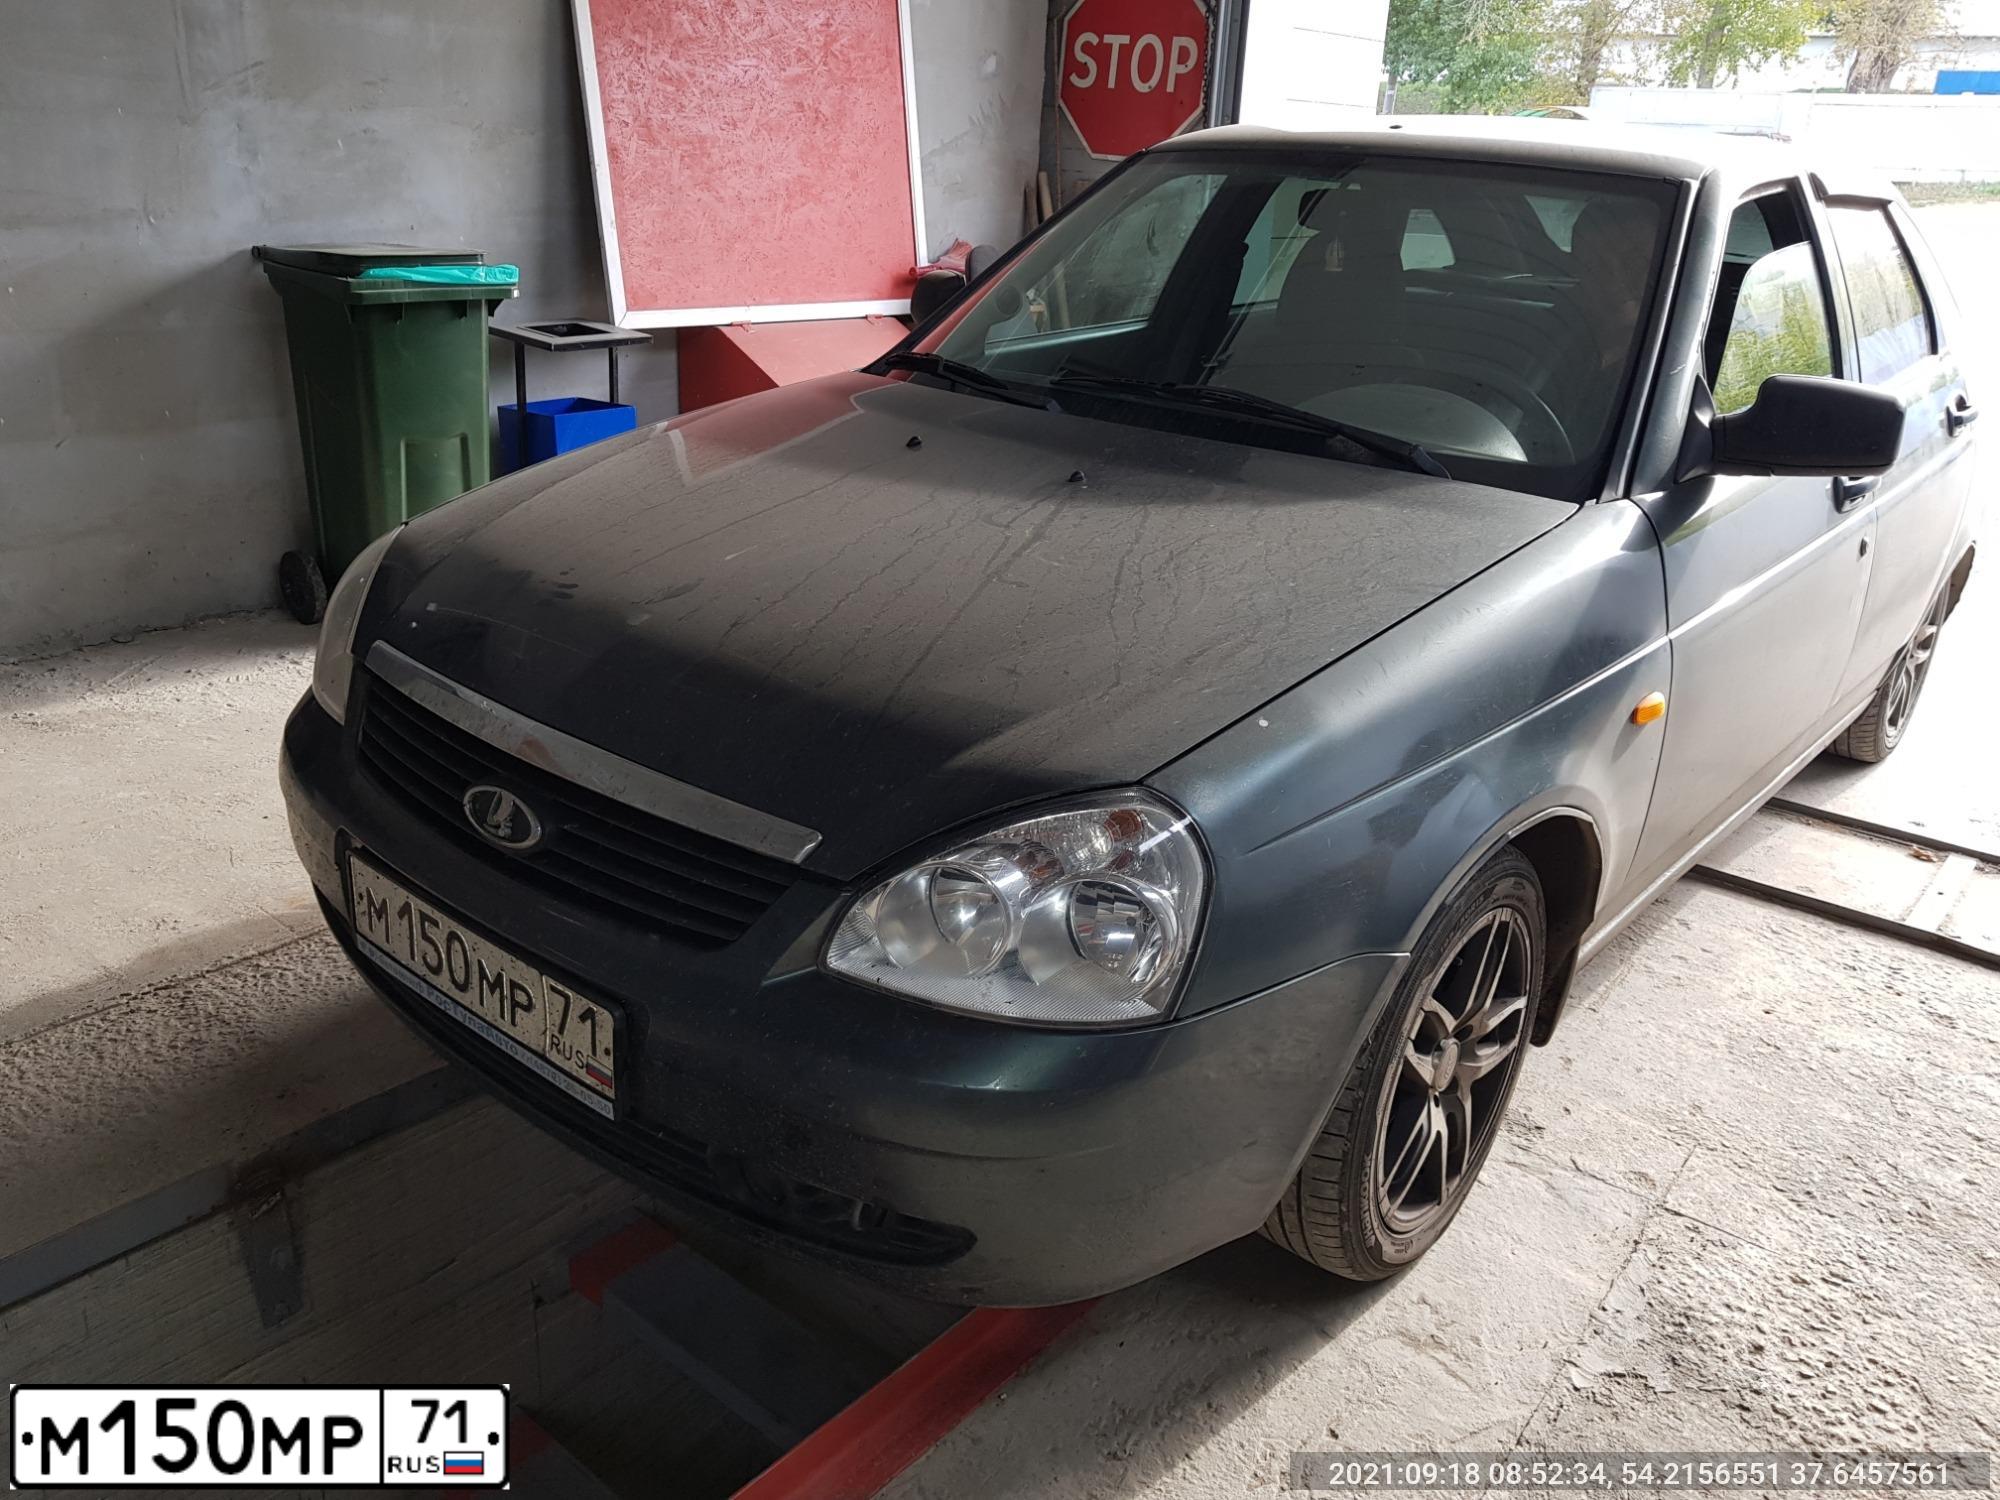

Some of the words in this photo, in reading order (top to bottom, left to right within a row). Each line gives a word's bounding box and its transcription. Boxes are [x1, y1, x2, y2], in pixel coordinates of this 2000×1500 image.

[1069, 31, 1199, 94] STOP
[549, 983, 598, 1057] 71
[550, 1033, 586, 1070] RUS
